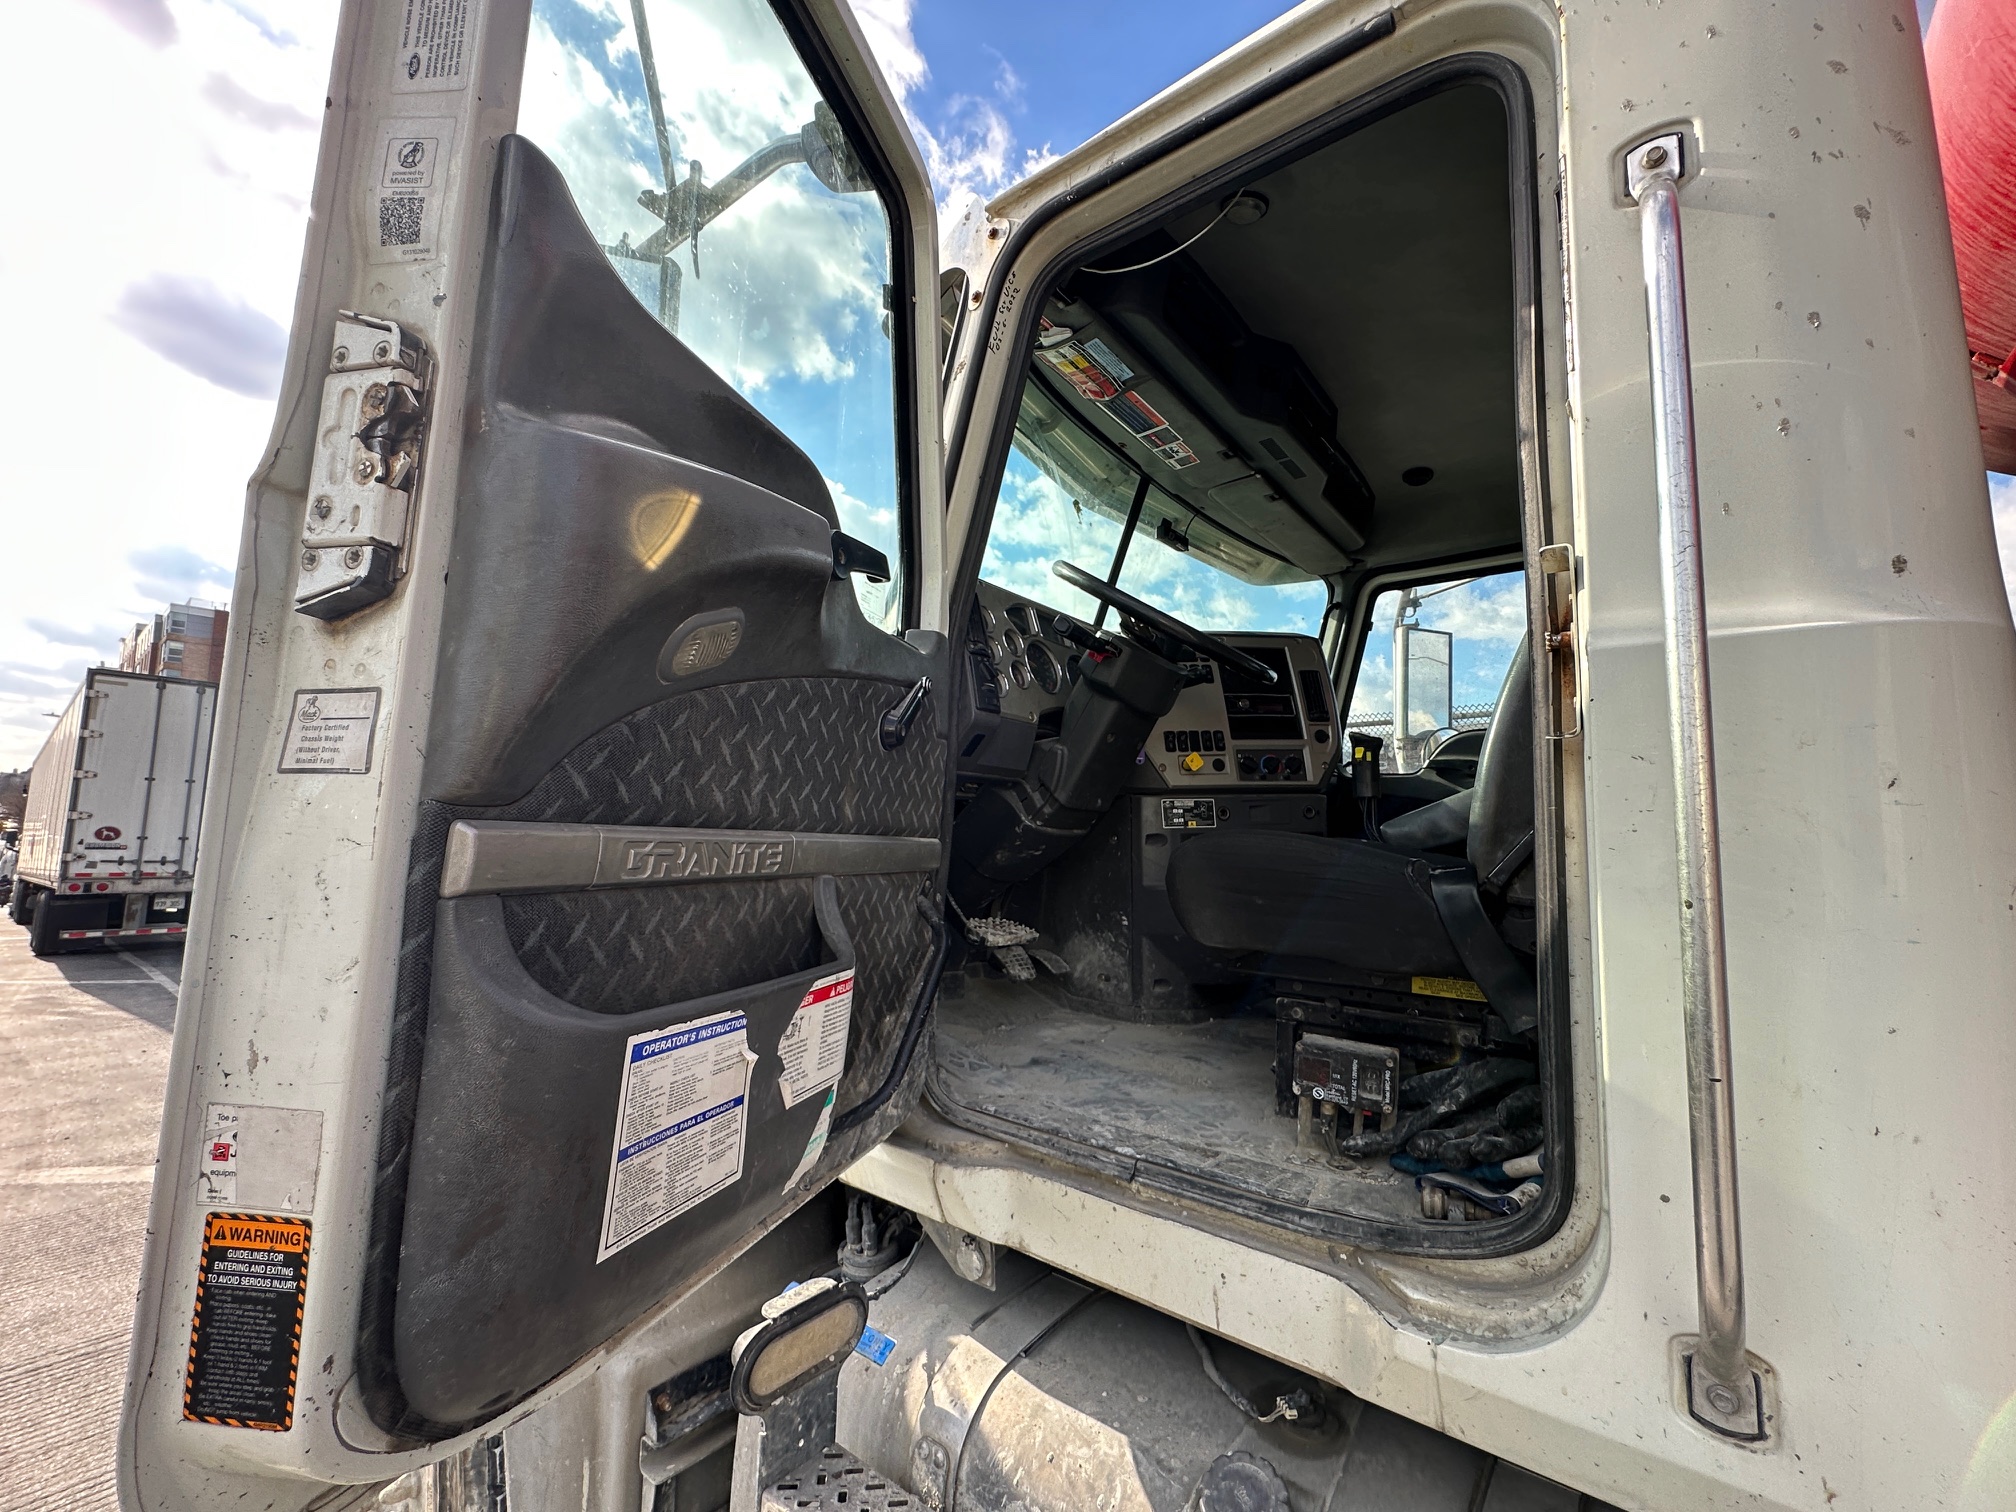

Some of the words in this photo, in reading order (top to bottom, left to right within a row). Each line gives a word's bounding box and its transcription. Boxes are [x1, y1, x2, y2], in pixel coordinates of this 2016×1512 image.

[430, 10, 438, 42] PROHIBITED
[447, 21, 451, 29] OR
[459, 30, 464, 38] OR
[620, 840, 784, 879] GRANITE
[642, 1032, 696, 1056] OPERATOR'S
[698, 1017, 748, 1039] INSTRUCTION
[627, 1127, 678, 1155] INSTRUCCIONES
[680, 1120, 696, 1130] PARA
[697, 1114, 704, 1122] EL
[706, 1101, 735, 1118] OPERADOR
[230, 1227, 301, 1246] WARNING
[227, 1249, 268, 1260] GUIDELINES
[269, 1253, 284, 1262] FOR
[214, 1262, 249, 1272] ENTERING
[250, 1265, 266, 1273] AND
[266, 1267, 294, 1276] EXITING
[207, 1274, 218, 1282] TO
[218, 1275, 240, 1285] AVOID
[241, 1276, 272, 1288] SERIOUS
[272, 1280, 297, 1289] INJURY
